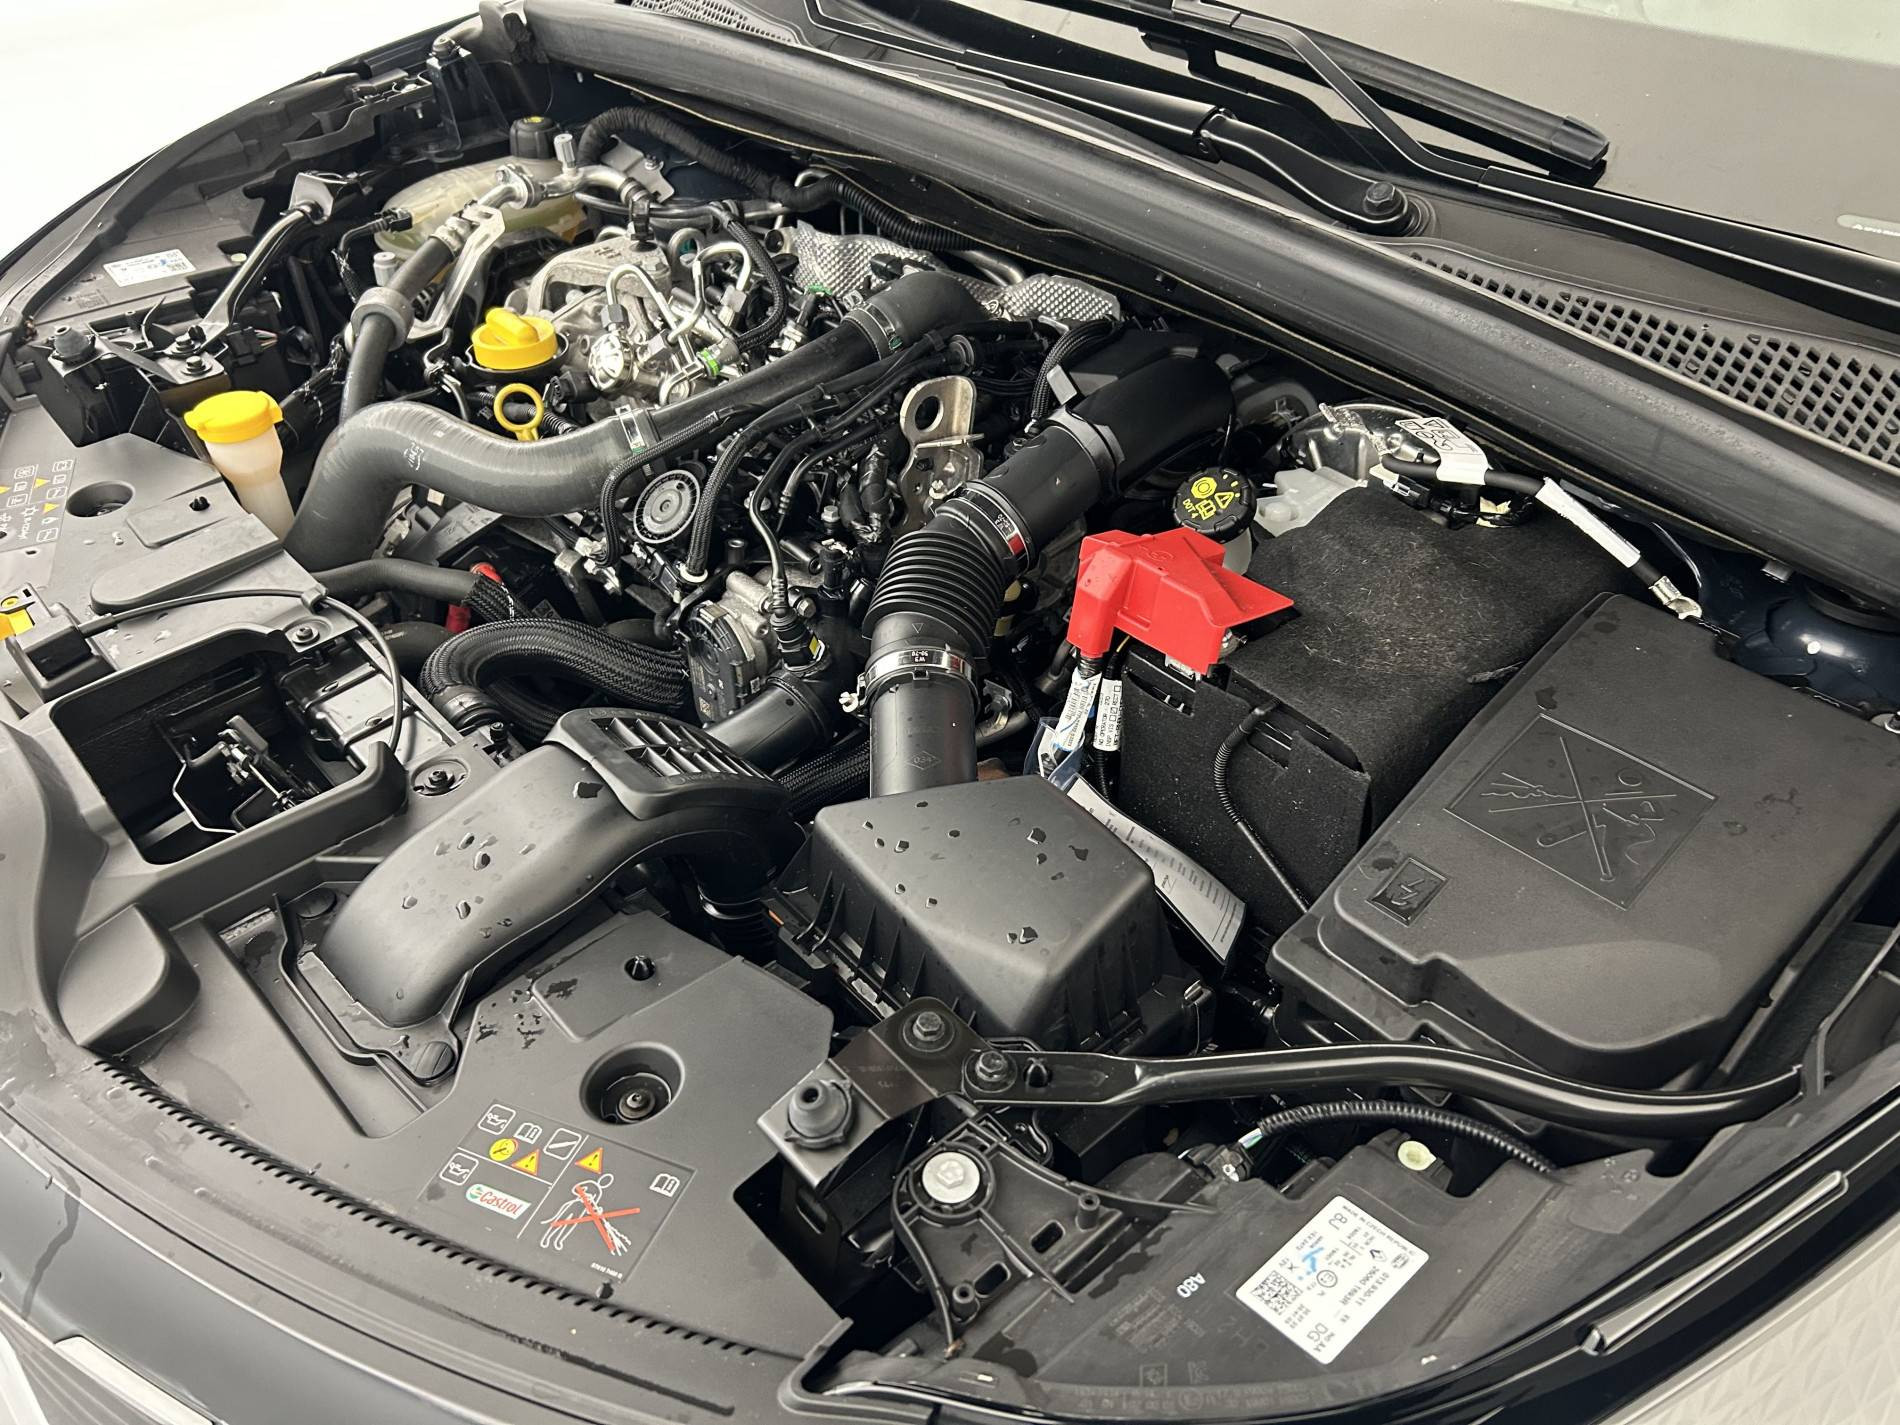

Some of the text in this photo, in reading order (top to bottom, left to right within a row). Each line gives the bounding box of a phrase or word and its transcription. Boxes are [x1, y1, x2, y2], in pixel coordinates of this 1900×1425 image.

[1183, 498, 1196, 513] DOT
[1099, 712, 1107, 737] OPERATOR
[479, 1191, 523, 1216] Castrol
[1328, 1212, 1348, 1230] 8J
[1177, 1272, 1206, 1298] A80
[1306, 1322, 1328, 1343] DG
